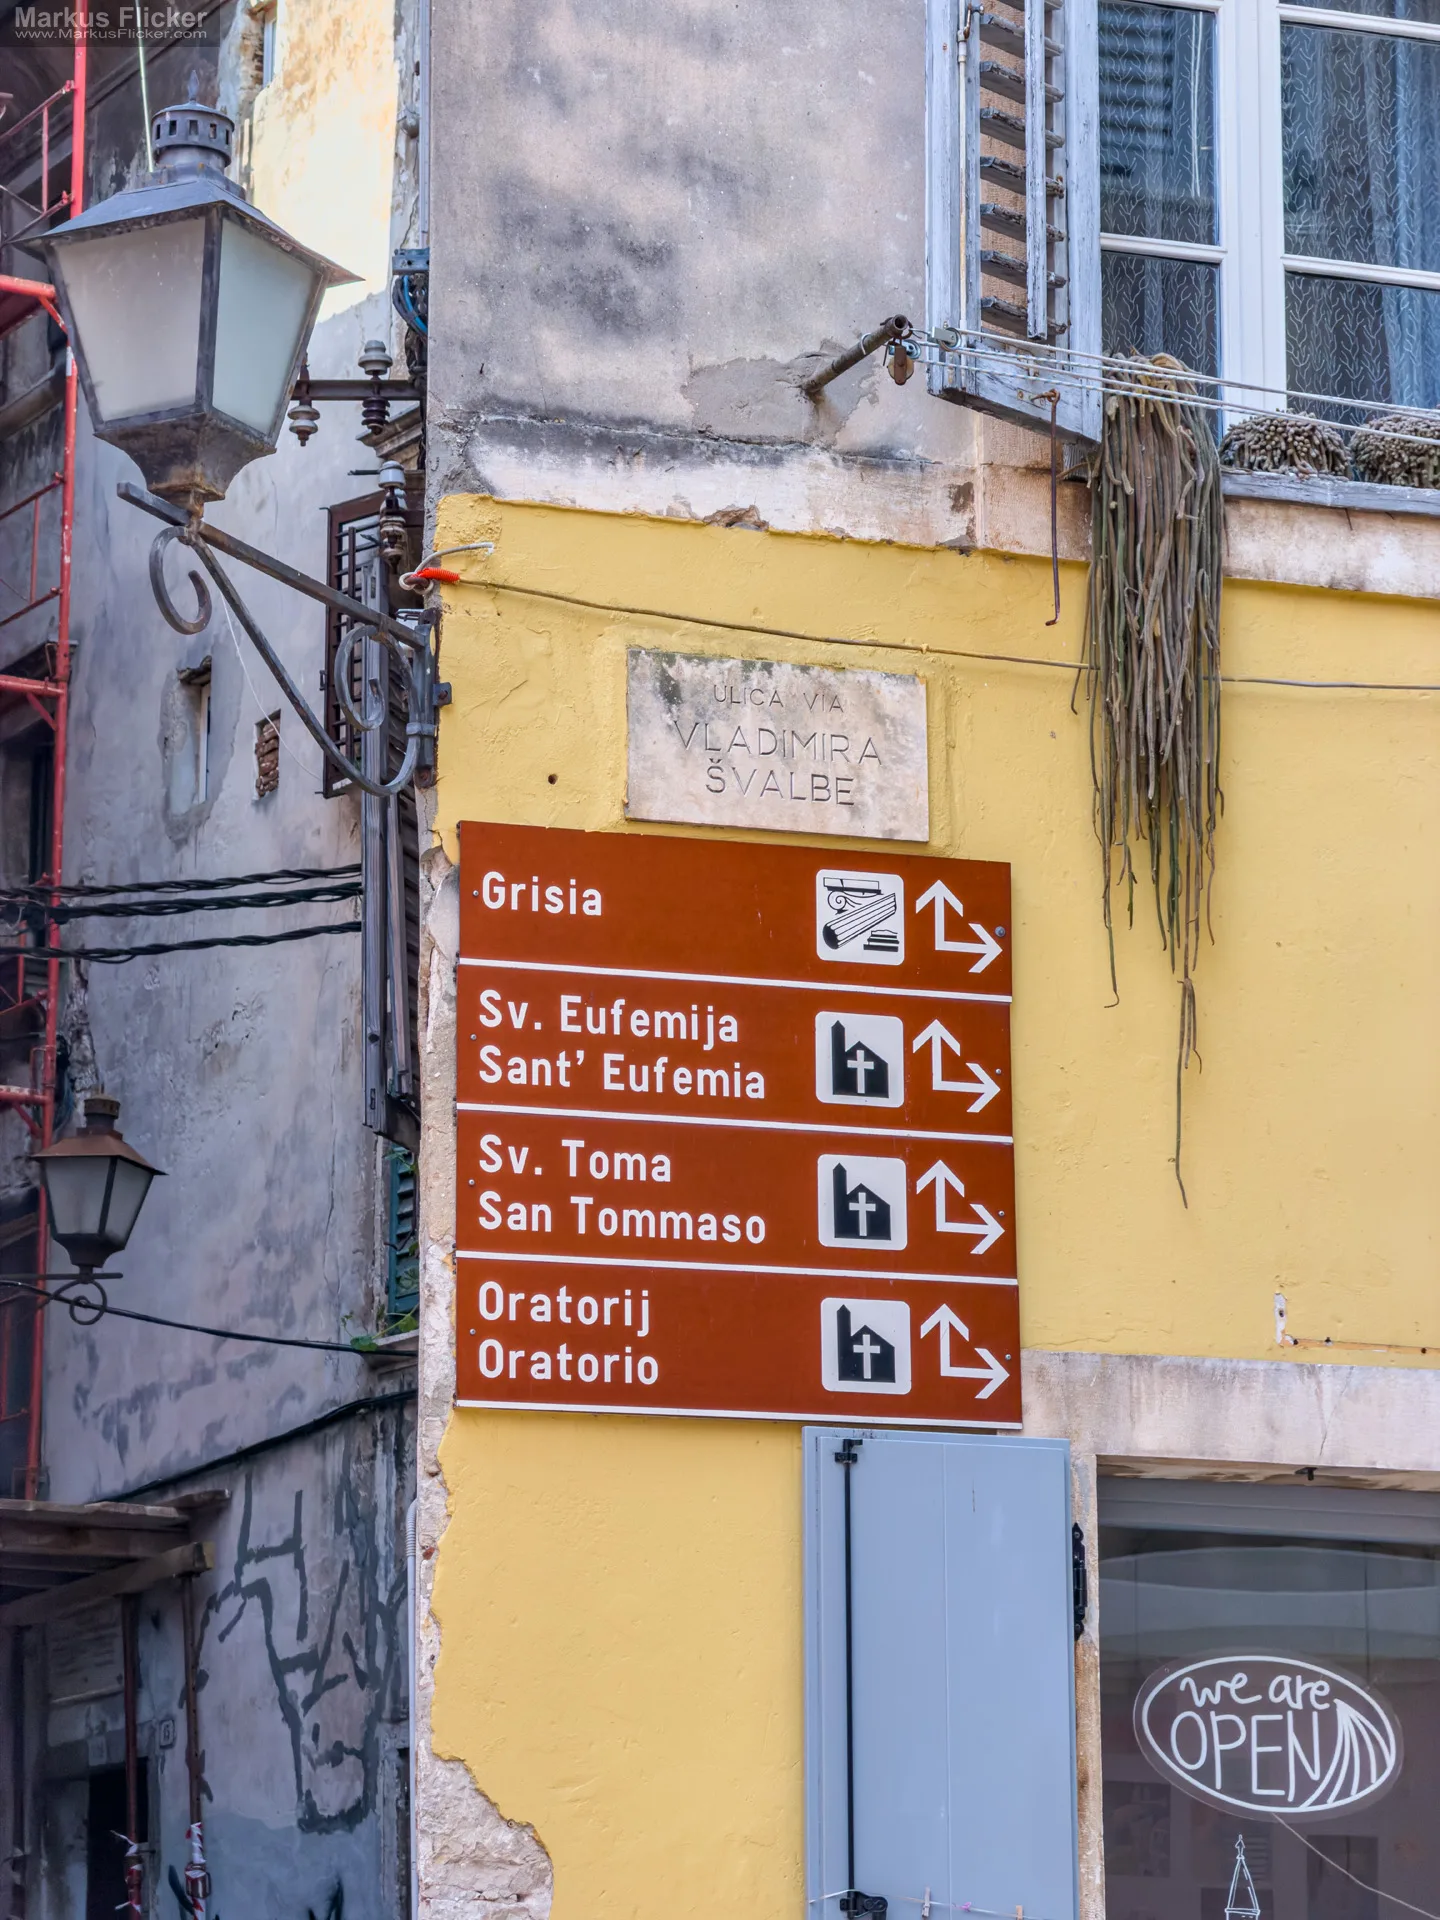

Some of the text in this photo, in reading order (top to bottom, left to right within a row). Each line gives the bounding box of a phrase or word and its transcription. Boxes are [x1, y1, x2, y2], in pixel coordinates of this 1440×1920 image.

[713, 684, 844, 713] ULICA VIA
[673, 720, 882, 765] VLADIMIRA
[705, 758, 855, 806] ŠVALBE
[481, 870, 603, 917] Grisia
[478, 988, 739, 1051] Sv. Eufemija
[602, 1052, 765, 1100] Eufemia
[478, 1133, 672, 1183] Sv. Toma
[478, 1189, 766, 1245] San Tommaso
[478, 1280, 650, 1338] Oratorij
[478, 1338, 659, 1386] Oratorio
[1179, 1672, 1331, 1710] we are
[1170, 1710, 1321, 1803] OPEN
